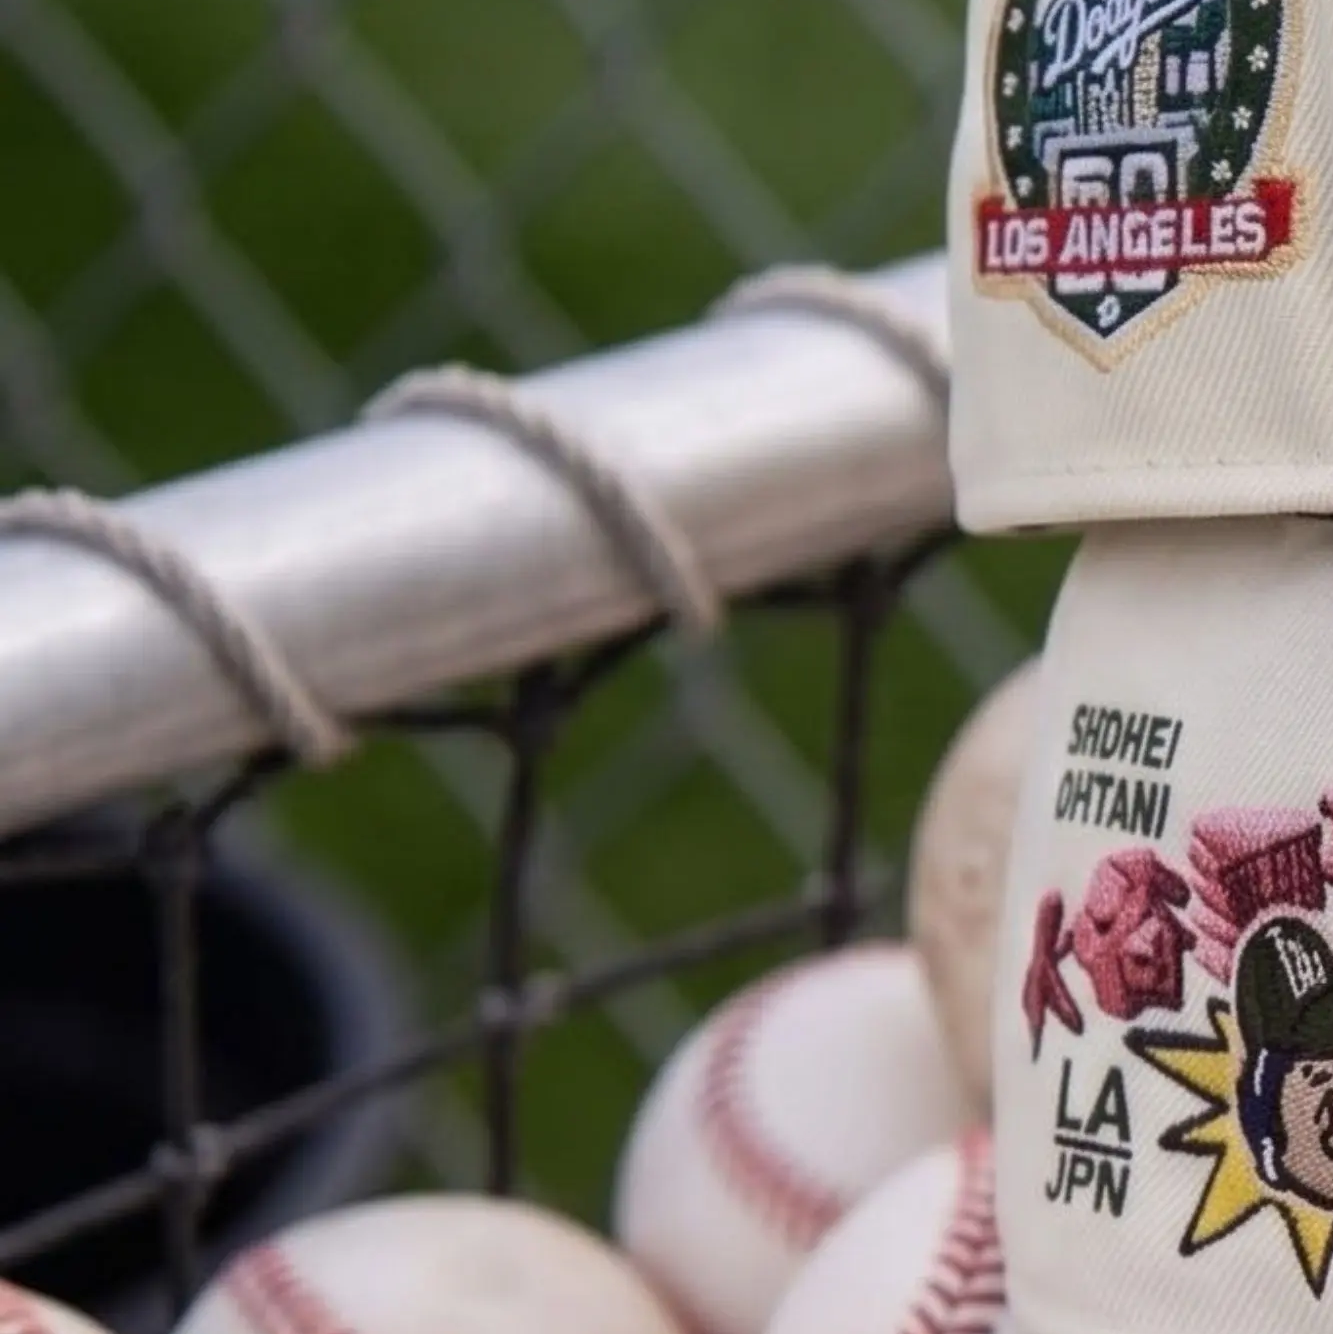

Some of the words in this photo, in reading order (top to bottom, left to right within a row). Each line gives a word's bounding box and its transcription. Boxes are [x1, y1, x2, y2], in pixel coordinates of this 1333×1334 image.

[986, 217, 1049, 268] LOS
[1058, 203, 1267, 264] ANGELES
[1067, 703, 1183, 770] SHOHEI
[1054, 768, 1171, 840] OHTANI
[1056, 1058, 1132, 1143] LA
[1045, 1149, 1132, 1217] JPN
